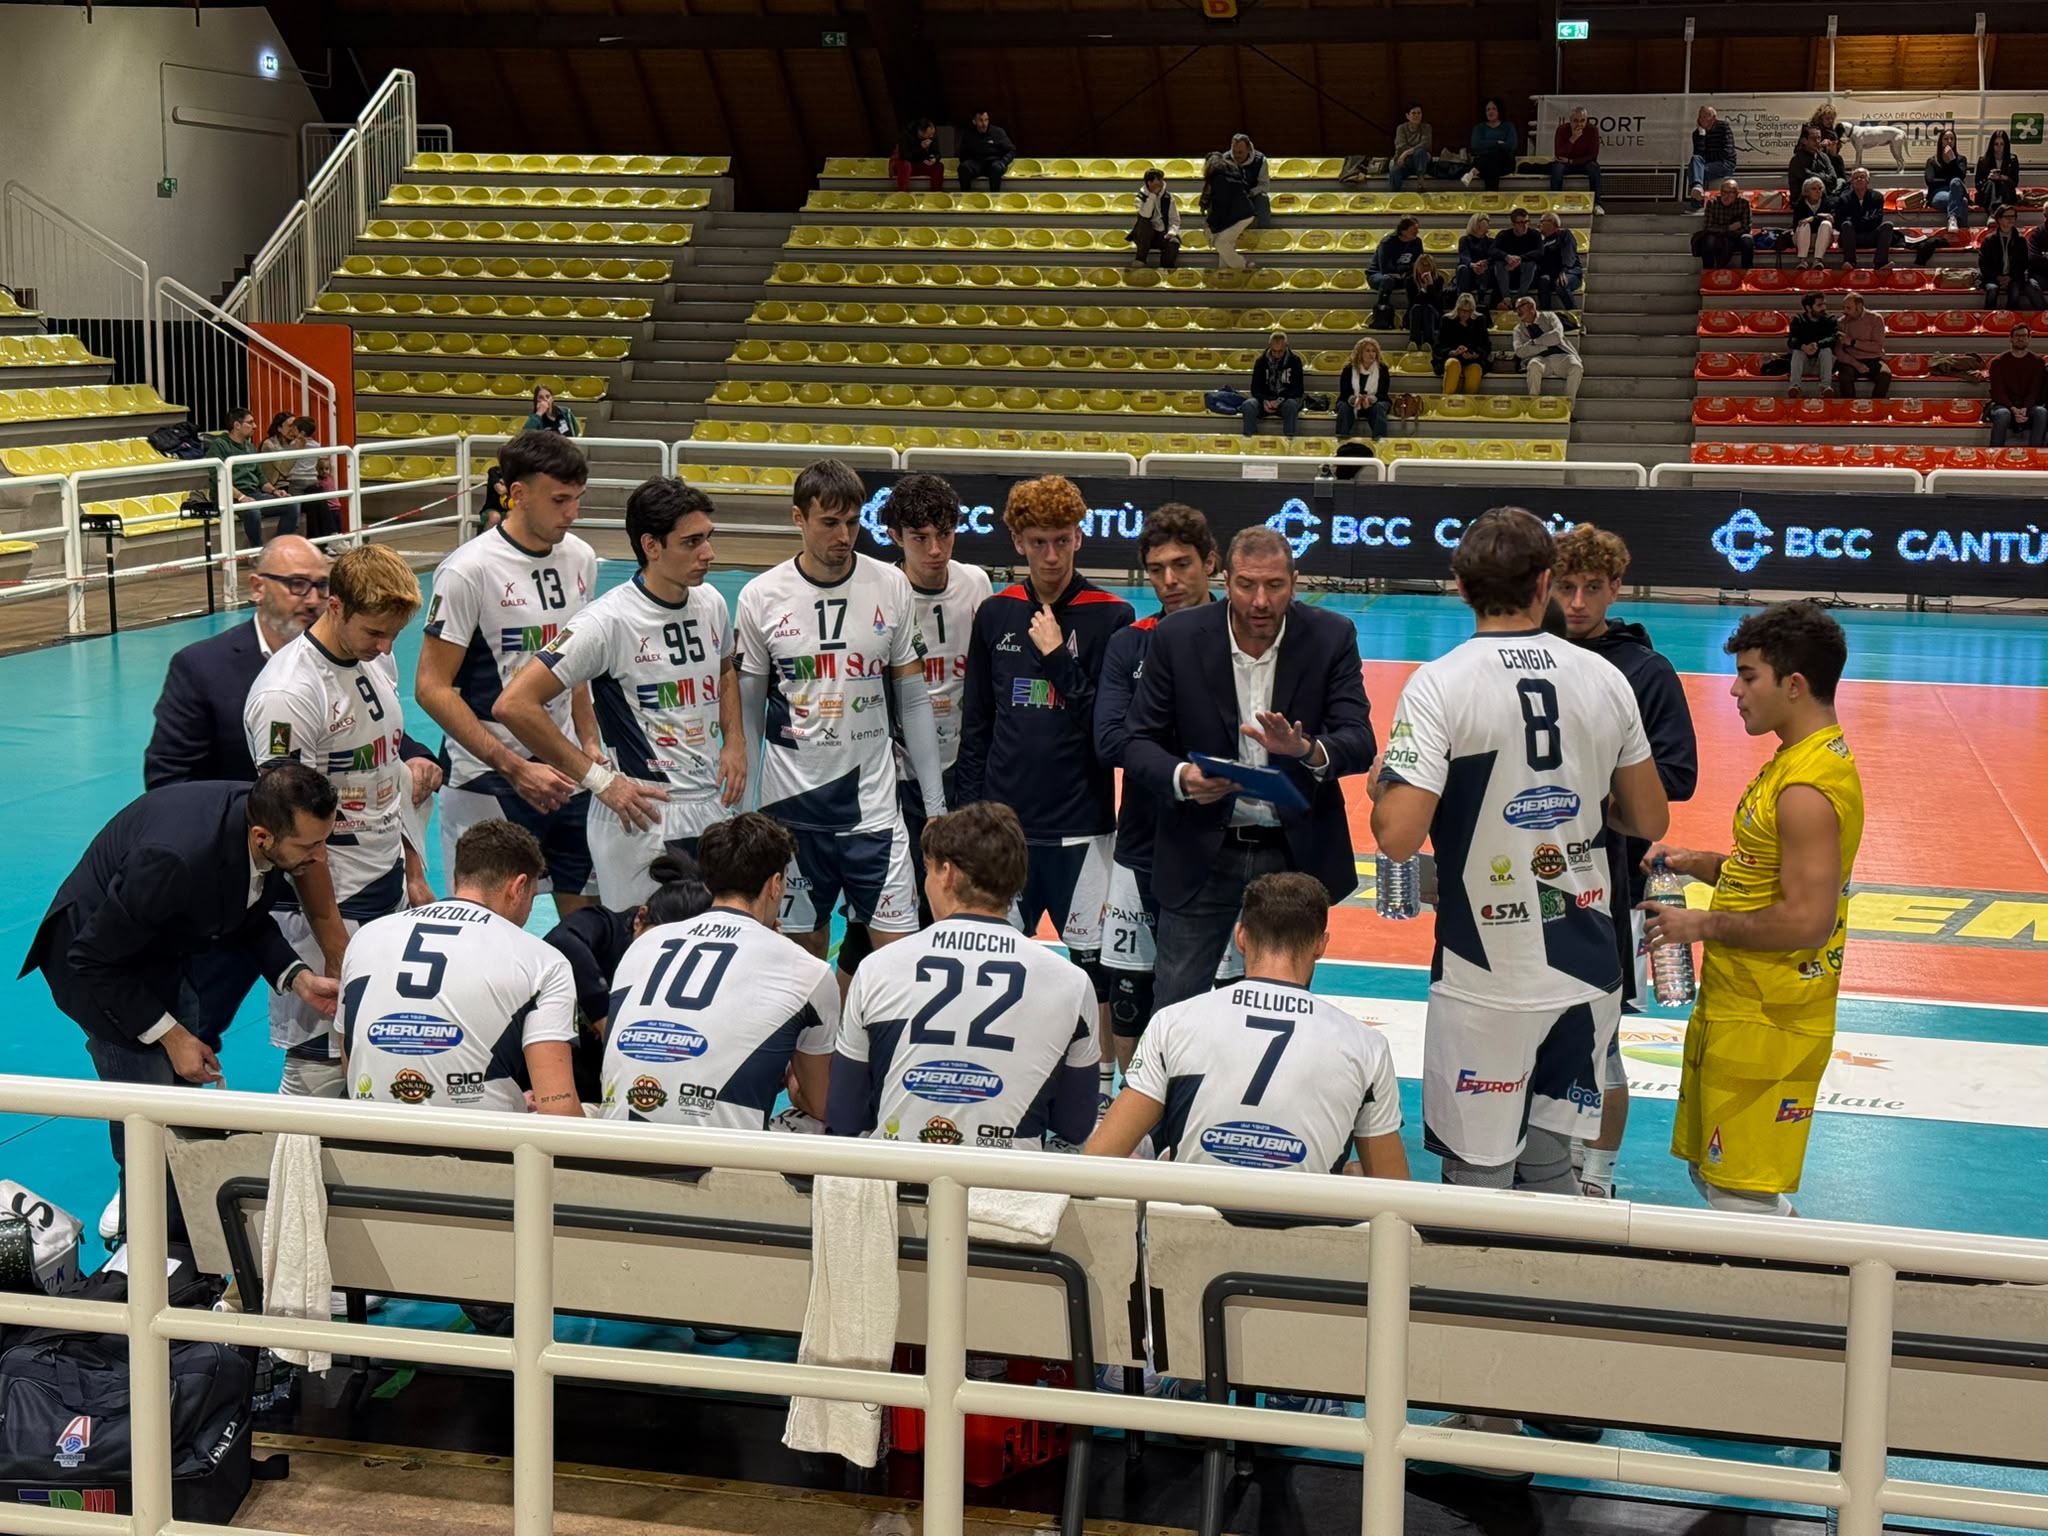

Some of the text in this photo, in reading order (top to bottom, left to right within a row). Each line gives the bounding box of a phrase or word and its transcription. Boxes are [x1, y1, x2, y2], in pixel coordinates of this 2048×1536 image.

[1592, 117, 1646, 132] PORT
[1754, 114, 1780, 122] Ufficio
[1756, 123, 1798, 131] Scolastico
[1599, 135, 1644, 147] ALUTE
[1759, 131, 1773, 140] per
[1331, 515, 1411, 546] BCC
[1785, 523, 2048, 565] BCC CANTÙ
[531, 568, 566, 610] 13
[501, 598, 528, 608] GALEX
[814, 598, 847, 640] 17
[933, 604, 946, 644] 1
[663, 619, 706, 666] 95
[774, 628, 801, 638] GALEX
[996, 642, 1022, 653] GALEX
[635, 653, 662, 664] GALEX
[1498, 648, 1558, 670] CENGIA
[355, 675, 384, 722] 9
[330, 715, 356, 733] GALEX
[1516, 678, 1563, 772] 8
[403, 906, 492, 925] MARZOLLA
[875, 910, 902, 918] GALEX
[687, 923, 742, 939] ALPINI
[932, 931, 1016, 954] MAIOCCHI
[1114, 928, 1136, 954] 21
[396, 922, 463, 1000] 5
[639, 938, 739, 1011] 10
[909, 955, 1027, 1052] 22
[1232, 989, 1314, 1015] BELLUCCI
[369, 1024, 458, 1038] CHERUBINI
[618, 1031, 704, 1049] CHERUBINI
[1240, 1015, 1296, 1106] 7
[447, 1072, 483, 1085] GIO
[904, 1070, 1000, 1089] CHERUBINI
[447, 1084, 485, 1095] exclusive
[680, 1083, 717, 1100] GIO
[977, 1124, 1015, 1139] GIO
[1202, 1131, 1303, 1154] CHERUBINI
